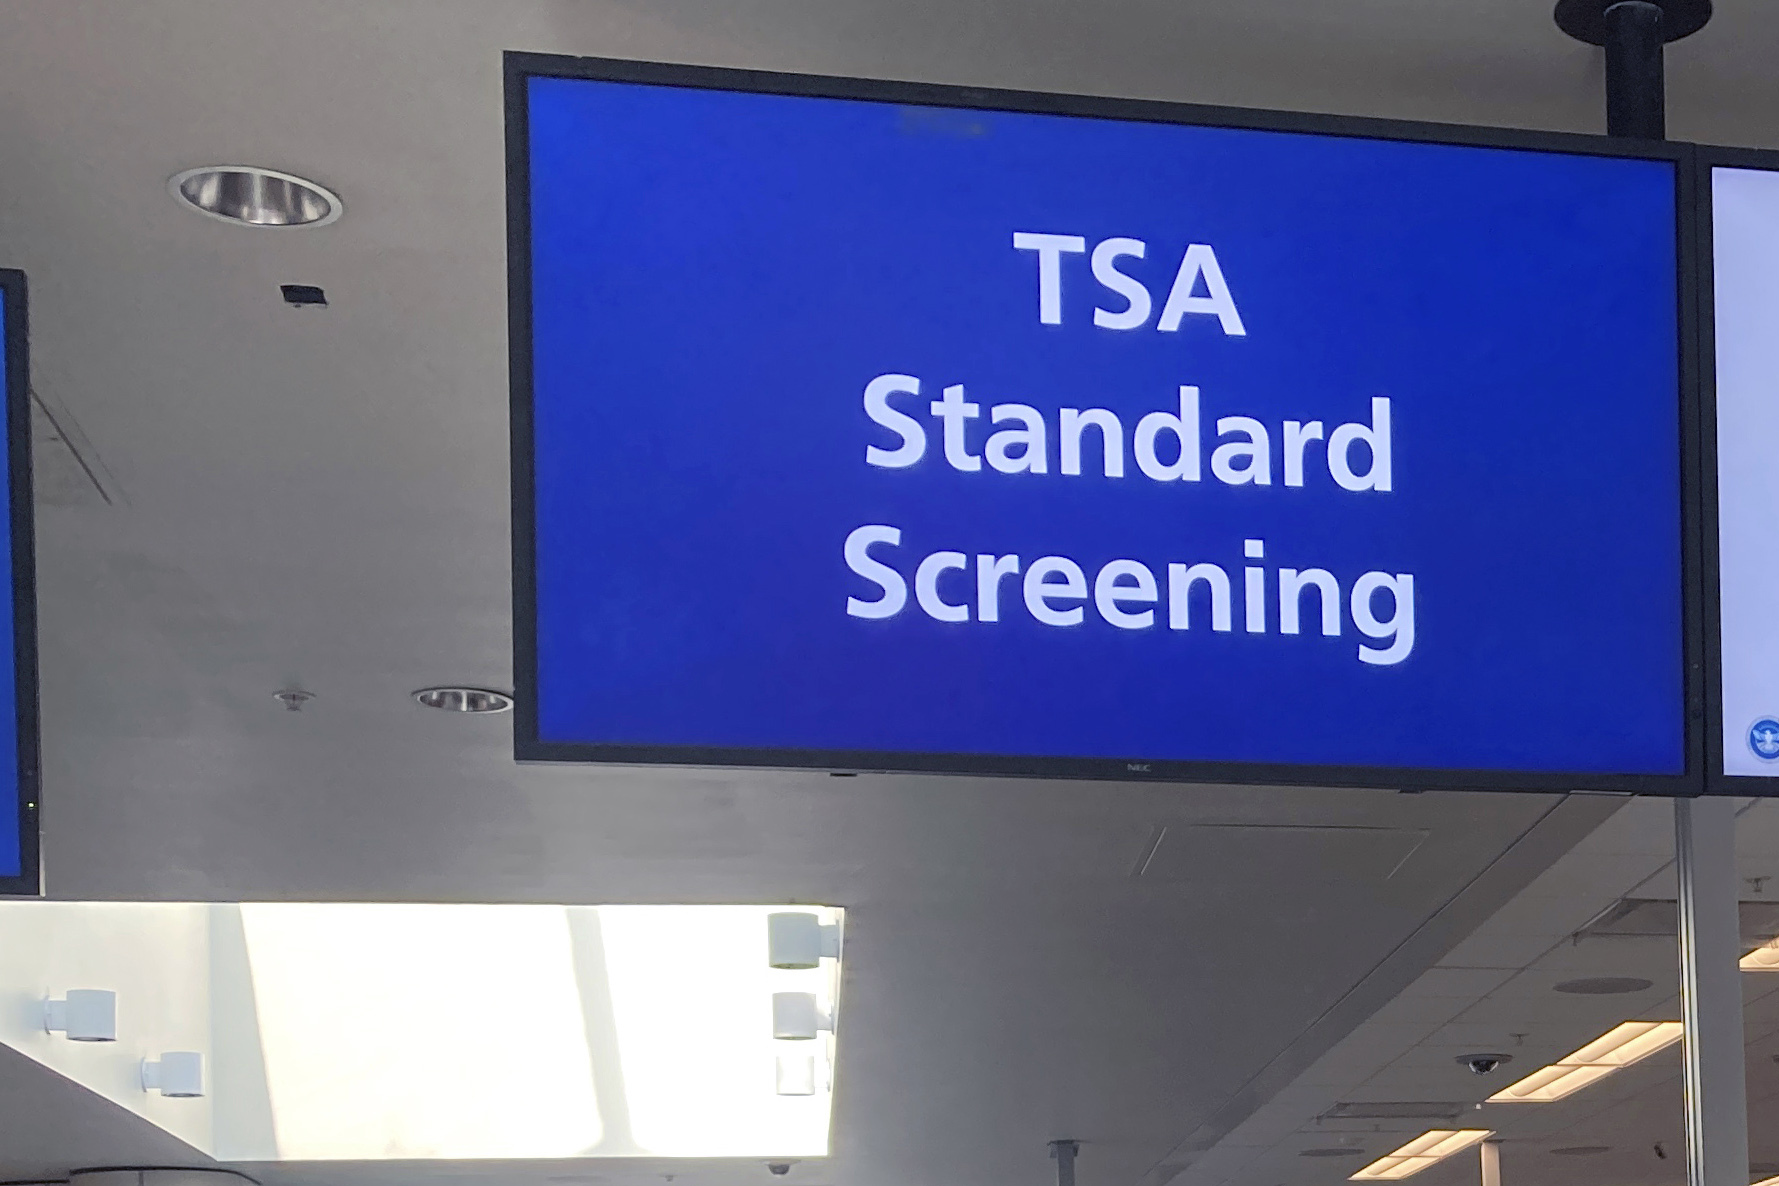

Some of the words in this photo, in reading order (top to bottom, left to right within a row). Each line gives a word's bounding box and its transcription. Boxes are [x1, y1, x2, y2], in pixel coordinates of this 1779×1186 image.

[1013, 232, 1247, 336] TSA
[863, 373, 1392, 492] Standard
[844, 524, 1415, 666] Screening
